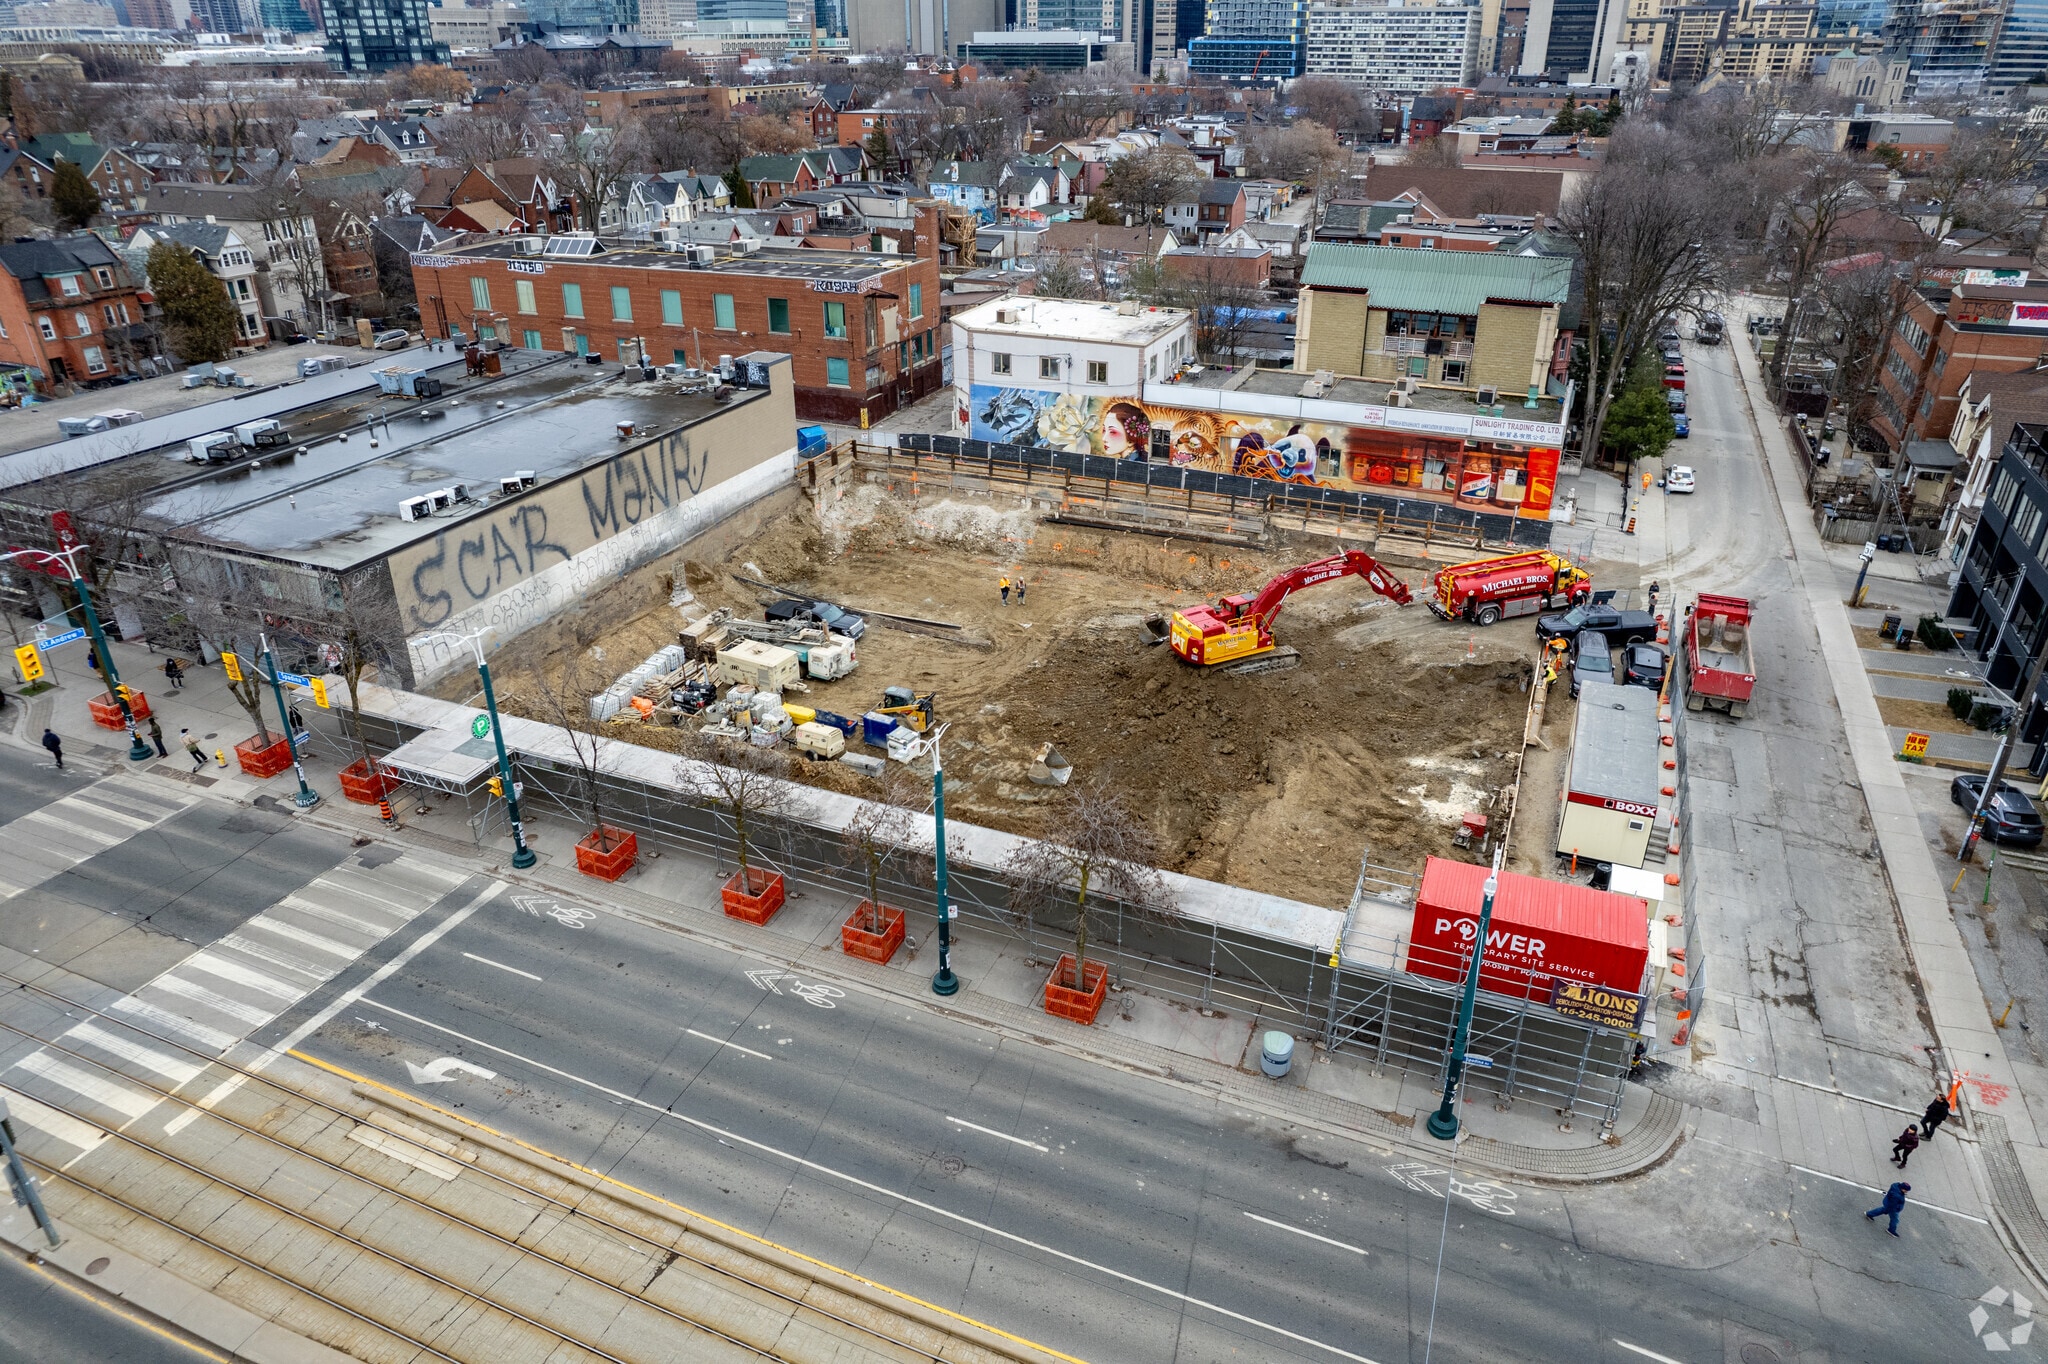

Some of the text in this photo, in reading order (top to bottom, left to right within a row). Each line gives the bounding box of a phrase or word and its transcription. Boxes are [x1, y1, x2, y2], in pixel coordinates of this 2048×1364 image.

[1475, 419, 1506, 429] SUNLIGHT
[1507, 422, 1534, 432] TRADING
[408, 504, 572, 630] SCAR
[1304, 569, 1342, 585] MICHAEL BROS.
[1482, 575, 1549, 594] MICHAEL BROS.
[50, 631, 78, 645] Andrew
[1172, 631, 1186, 651] CAT
[476, 719, 486, 732] P
[1905, 743, 1925, 753] TAX
[1615, 801, 1657, 816] BOXX
[1434, 917, 1547, 959] POWER
[1453, 941, 1596, 980] TEMORARY SITE SERVICE
[1573, 987, 1639, 1014] LIONS
